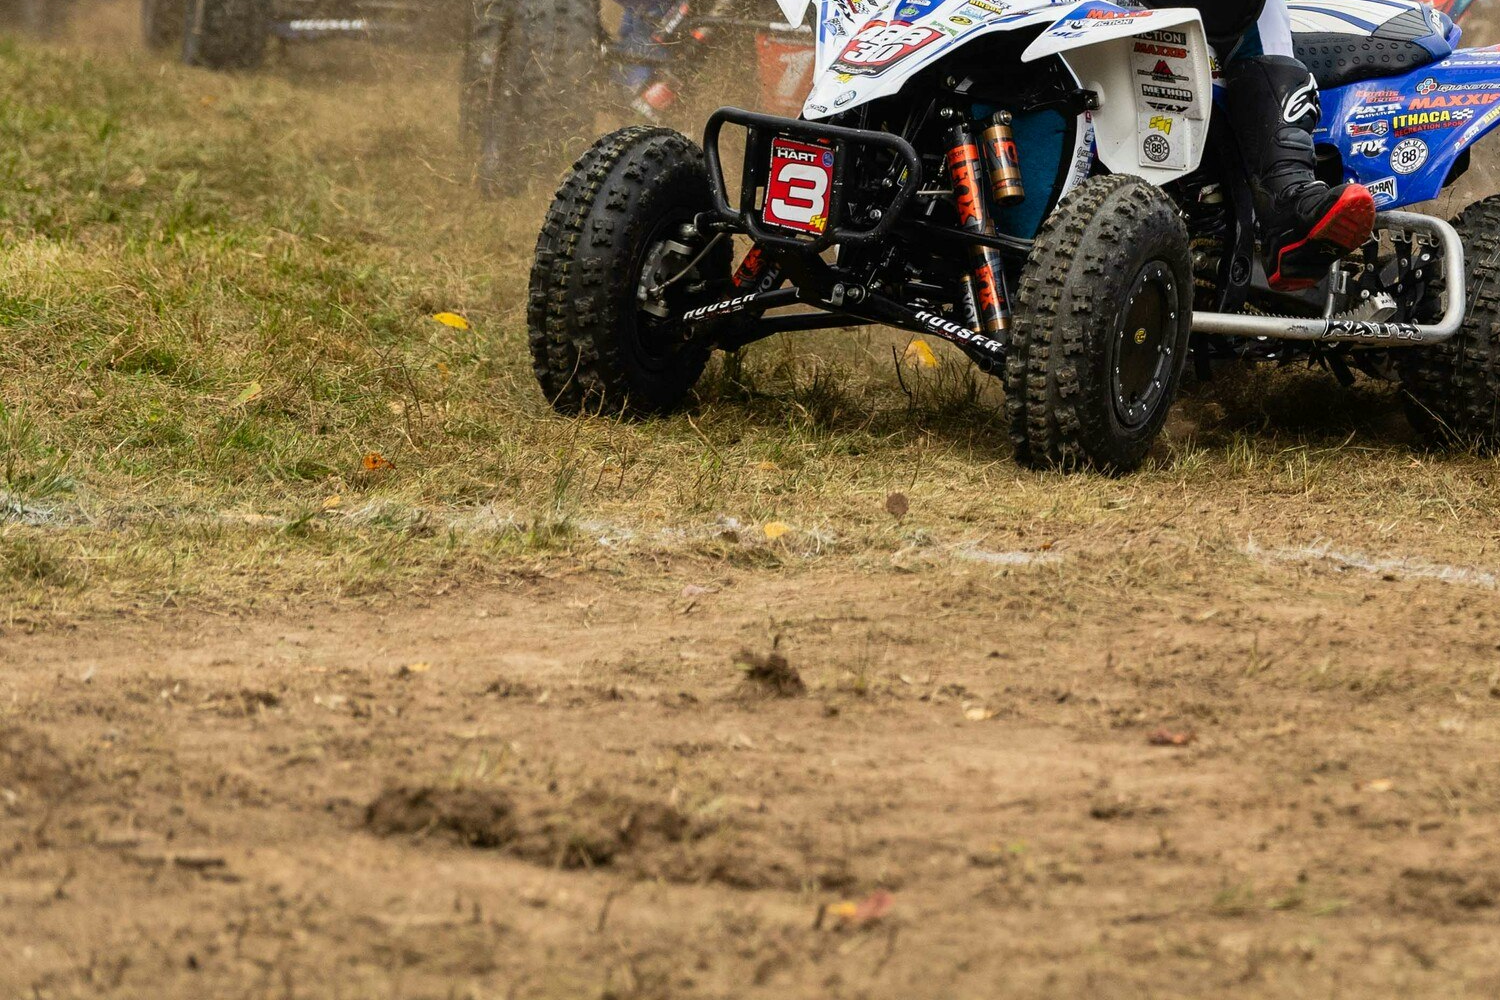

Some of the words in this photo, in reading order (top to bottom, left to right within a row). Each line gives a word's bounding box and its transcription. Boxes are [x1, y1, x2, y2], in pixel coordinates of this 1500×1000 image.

[1133, 42, 1188, 59] MAXXIS
[1142, 84, 1192, 98] METHOD
[1393, 110, 1451, 129] ITHACA
[1394, 123, 1441, 138] RECREATION
[777, 149, 818, 163] HART
[1151, 142, 1162, 154] 88
[1401, 149, 1417, 165] 88
[770, 162, 829, 224] 3
[683, 292, 756, 321] HOUSER
[914, 310, 1003, 352] HOUSER
